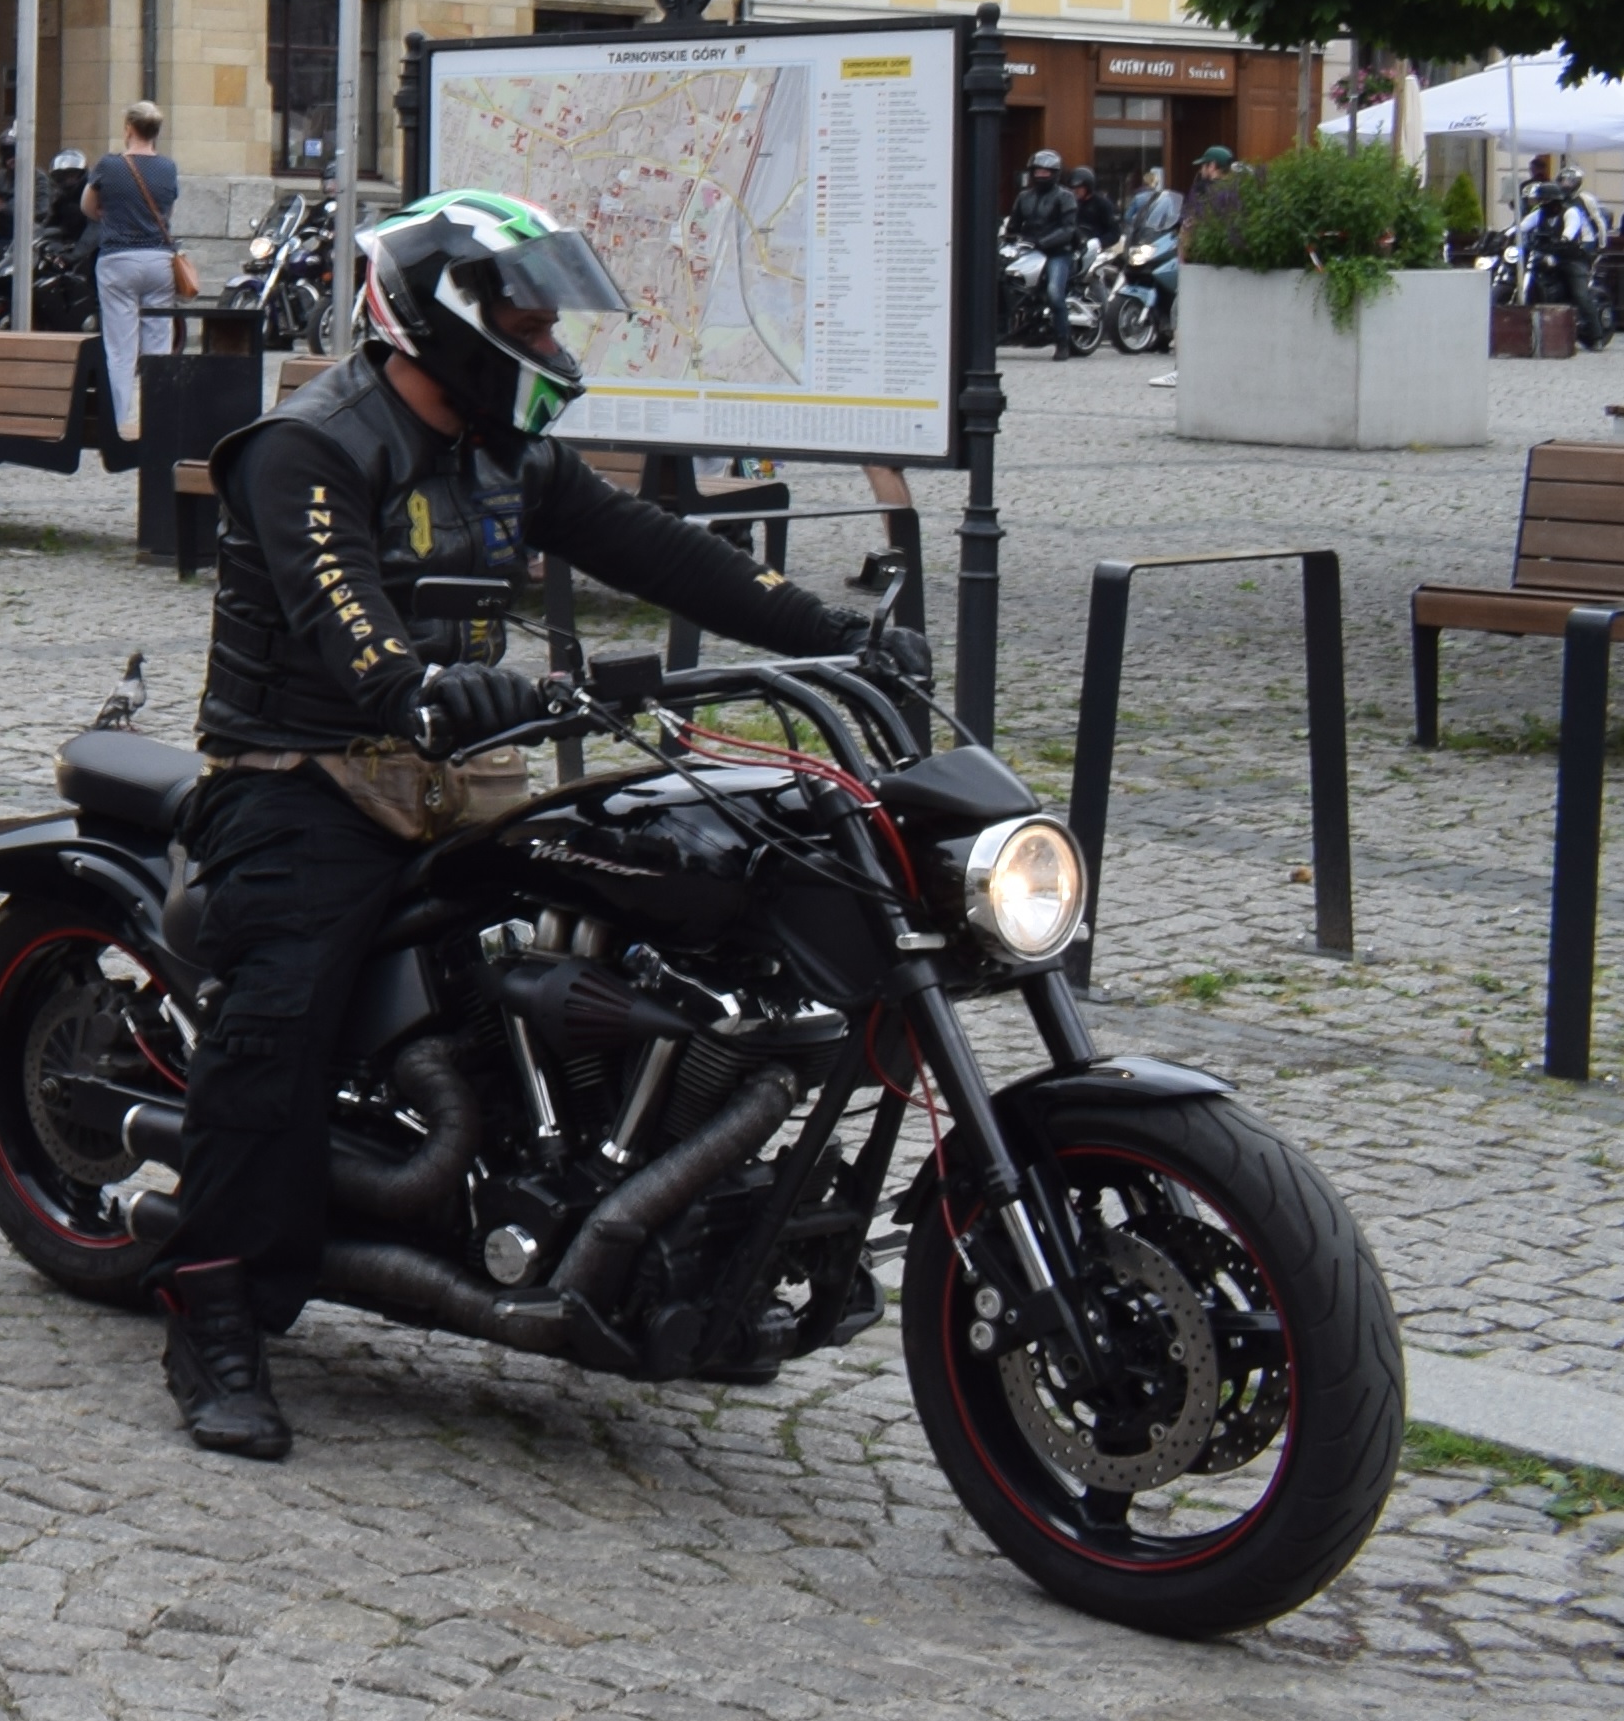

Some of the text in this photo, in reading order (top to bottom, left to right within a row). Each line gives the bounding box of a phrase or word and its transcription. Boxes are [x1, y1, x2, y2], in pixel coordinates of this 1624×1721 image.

[607, 46, 728, 64] TARNOWSKIE GÓRY
[306, 485, 373, 642] INVADERS
[530, 840, 666, 876] Warrior
